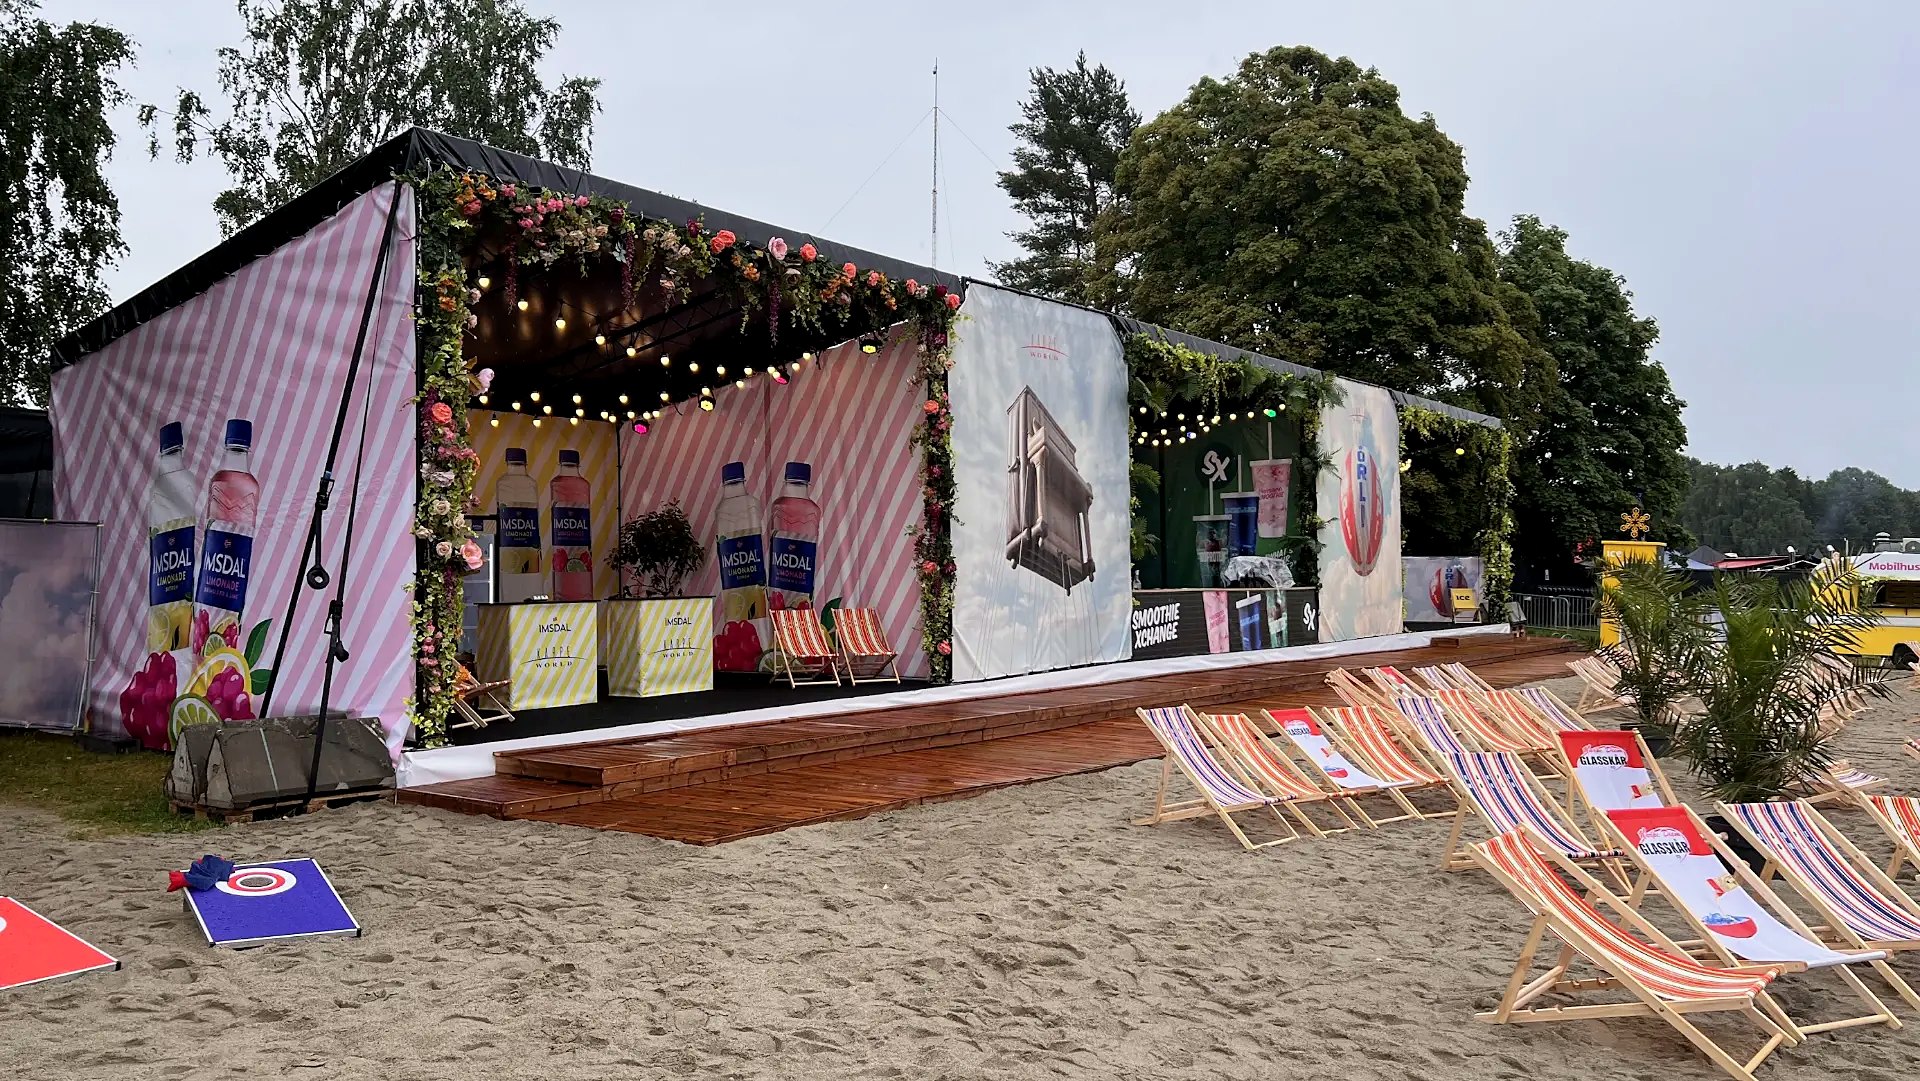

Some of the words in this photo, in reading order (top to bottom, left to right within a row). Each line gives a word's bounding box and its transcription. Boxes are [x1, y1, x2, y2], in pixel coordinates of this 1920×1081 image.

[1201, 450, 1230, 482] SX
[500, 518, 536, 530] IMSDAL
[553, 518, 588, 530] IMSDAL
[153, 547, 192, 574] IMSDAL
[204, 551, 245, 578] IMSDAL
[721, 549, 760, 568] IMSDAL
[772, 552, 811, 571] IMSDAL
[1868, 562, 1920, 571] Mobilhus
[157, 571, 186, 586] LIMONADE
[206, 575, 240, 591] LIMONADE
[664, 616, 692, 626] IMSDAL
[1131, 602, 1181, 630] SMOOTHIE
[1303, 602, 1316, 631] SX
[539, 623, 571, 633] IMSDAL
[1134, 621, 1179, 649] XCHANGE
